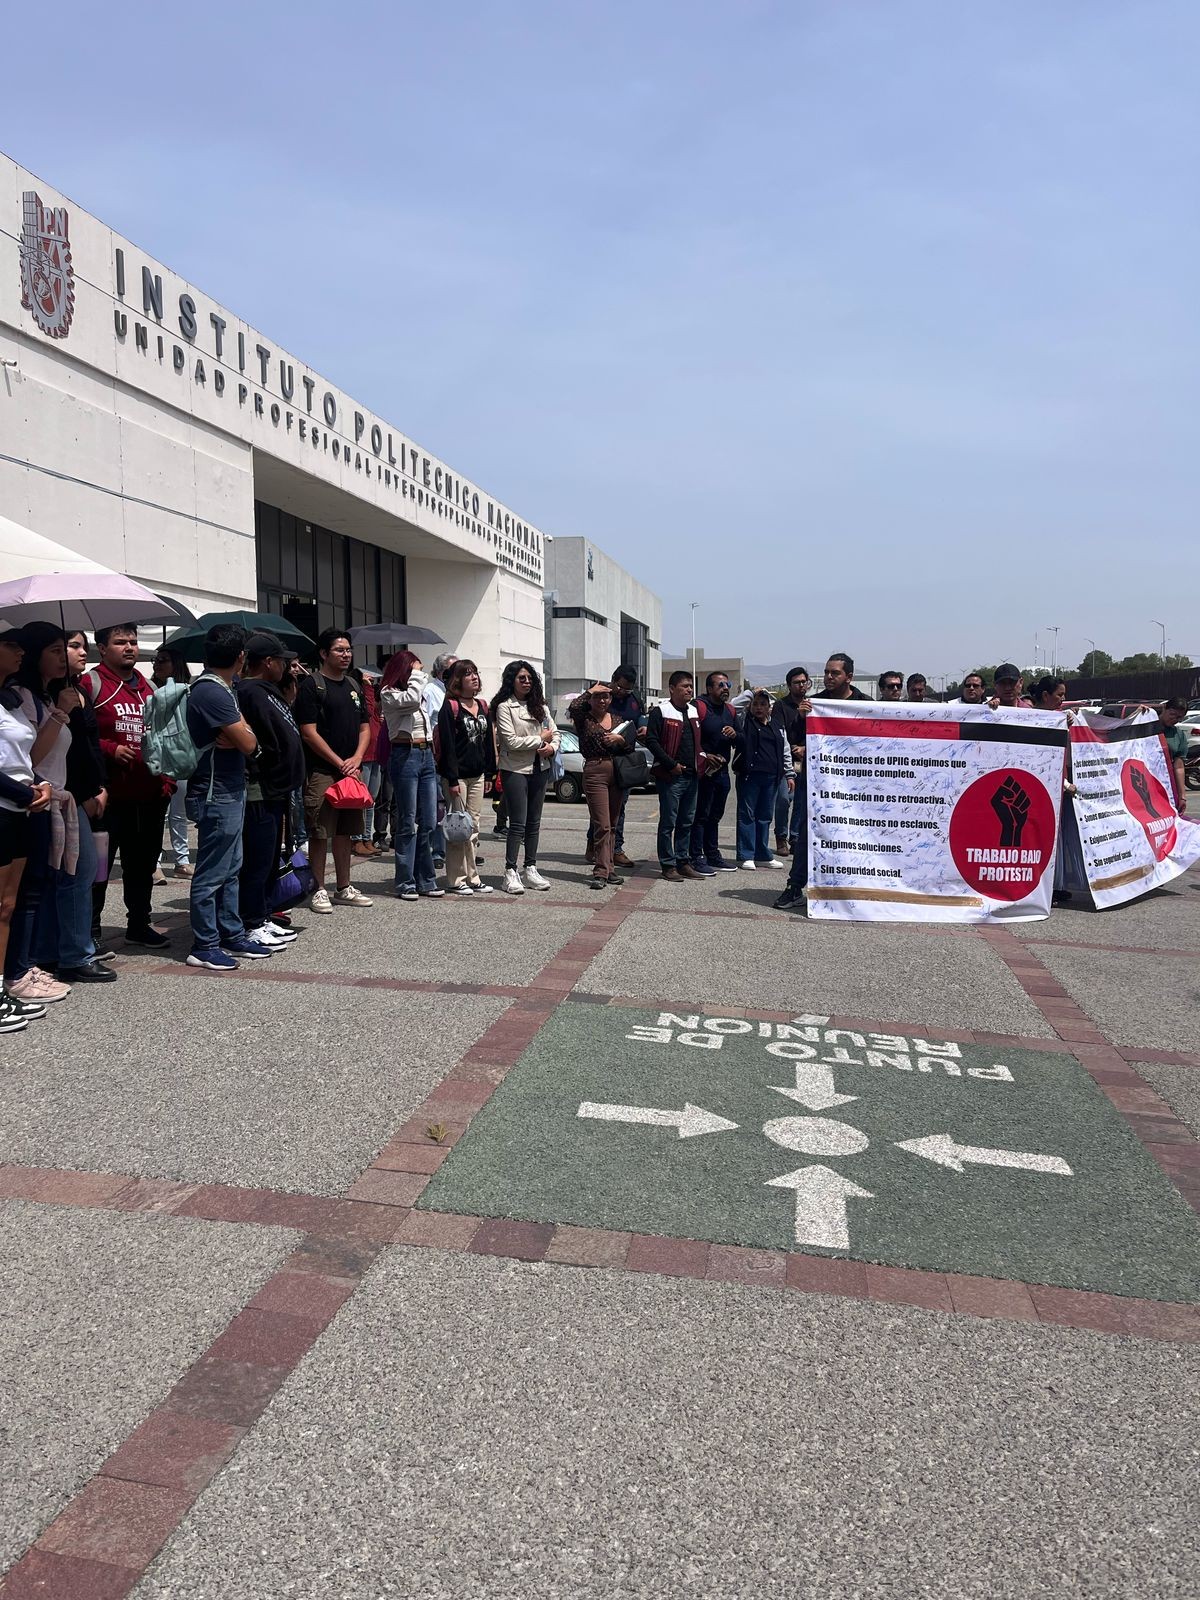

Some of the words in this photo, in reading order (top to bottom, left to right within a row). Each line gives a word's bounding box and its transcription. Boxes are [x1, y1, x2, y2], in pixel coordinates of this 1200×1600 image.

[37, 207, 68, 238] IPN
[115, 248, 337, 425] INSTITUTO
[354, 411, 480, 515] POLITECNICO
[487, 502, 540, 554] NACIONAL
[114, 310, 225, 391] UNIDAD
[239, 383, 371, 474] PROFESIONAL
[378, 465, 491, 542] INTERDISCIPLINARIA
[494, 533, 502, 549] DE
[115, 722, 143, 733] BOXING
[820, 753, 832, 762] Los
[833, 754, 873, 765] docentes
[874, 755, 886, 765] de
[887, 756, 909, 766] UPIIG
[911, 758, 949, 768] exigimos
[950, 760, 967, 770] que
[820, 766, 830, 774] se
[831, 767, 844, 776] nos
[846, 768, 873, 778] pague
[874, 769, 917, 779] completo.
[820, 790, 830, 799] La
[831, 791, 872, 802] educación
[874, 794, 884, 803] no
[886, 794, 897, 803] es
[898, 794, 947, 805] retroactiva.
[820, 814, 848, 825] Somos
[849, 817, 886, 828] maestros
[888, 819, 898, 828] no
[900, 818, 940, 830] esclavos.
[820, 840, 856, 851] Exigimos
[858, 843, 904, 853] soluciones.
[966, 848, 1018, 864] TRABAJO
[1020, 849, 1042, 864] BAJO
[820, 864, 835, 874] Sin
[836, 865, 876, 877] seguridad
[877, 867, 903, 878] social.
[978, 867, 1033, 882] PROTESTA
[625, 1024, 724, 1050] DE
[657, 1012, 964, 1058] REUNION
[764, 1041, 1015, 1082] PUNTO
